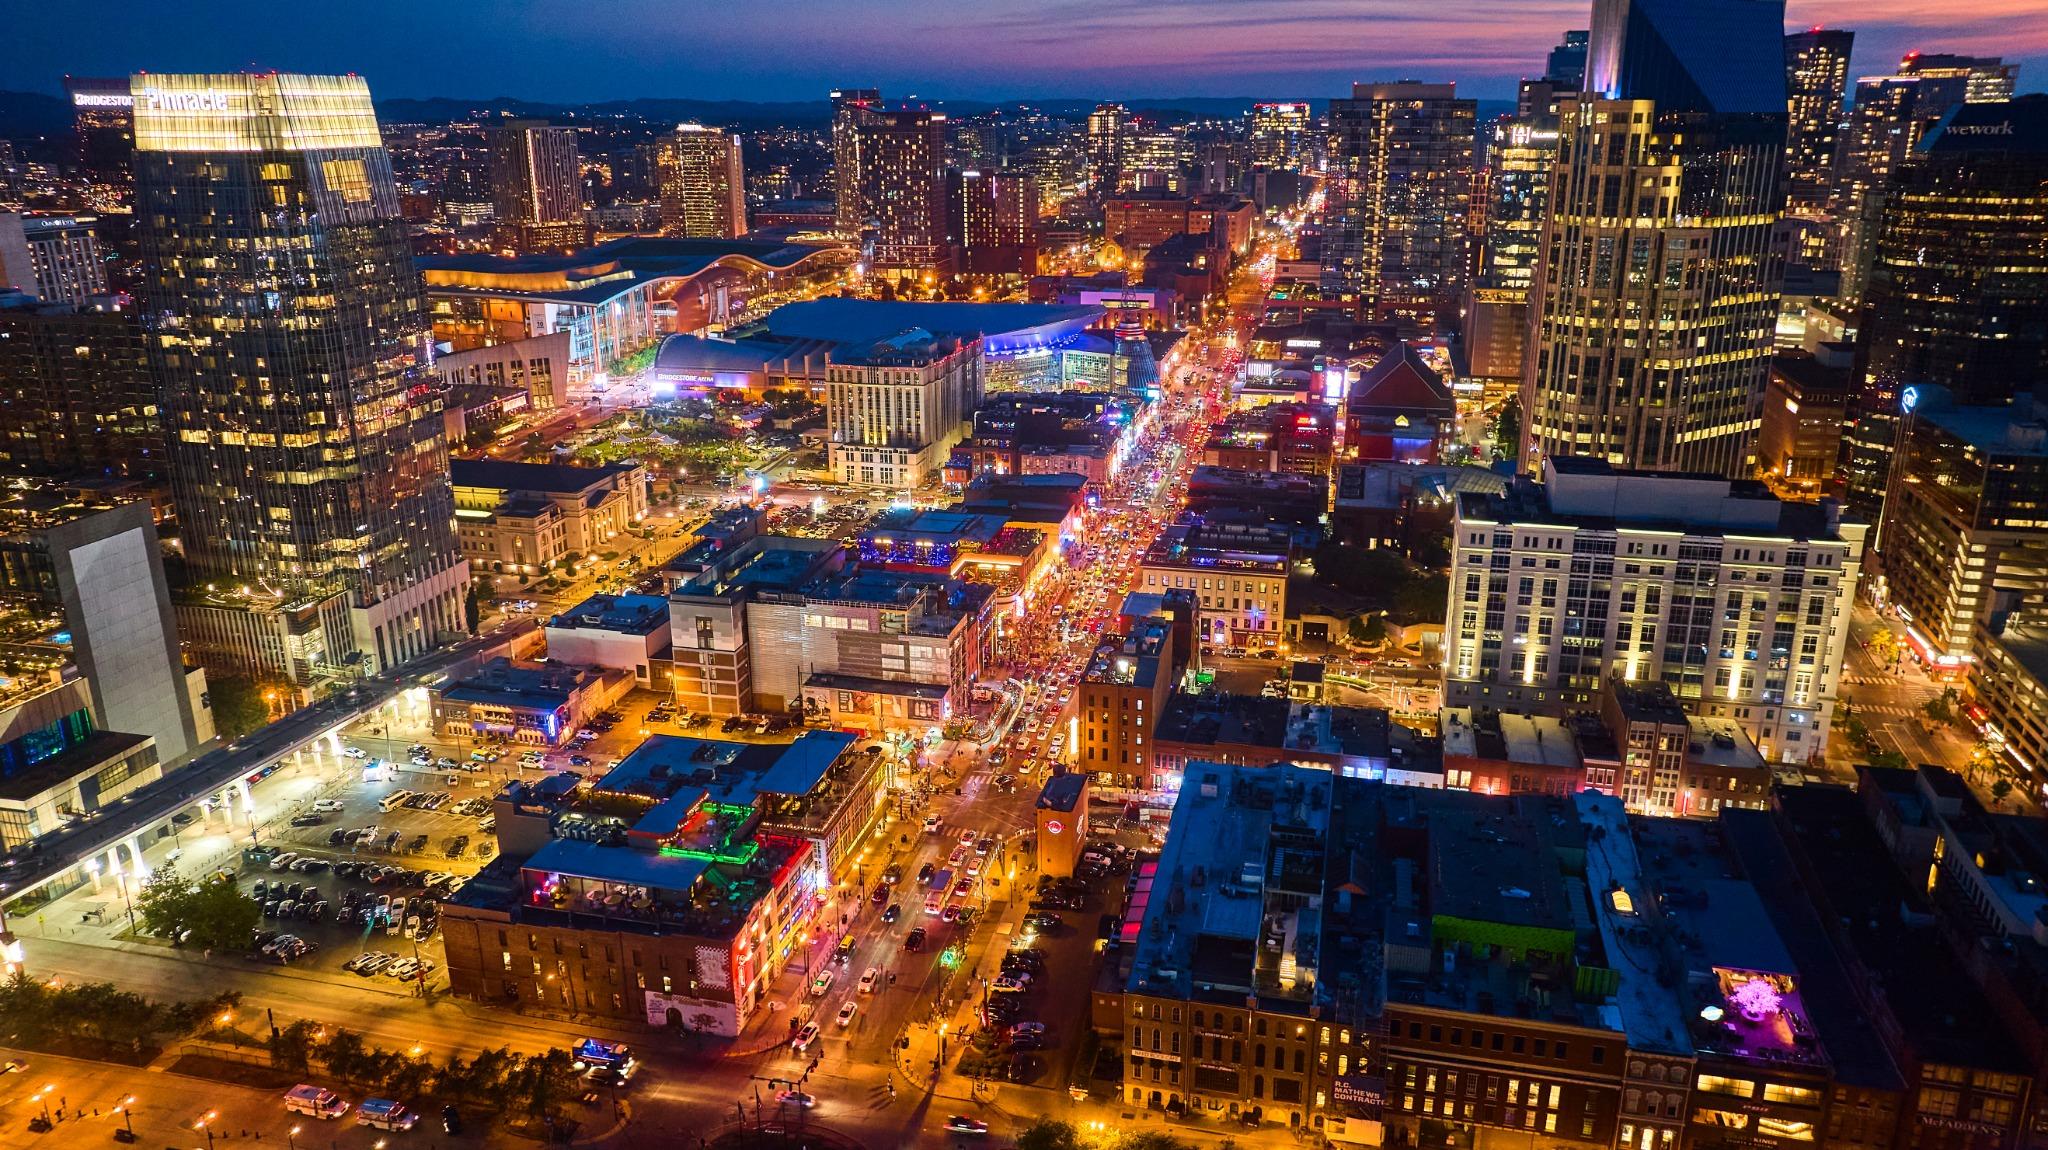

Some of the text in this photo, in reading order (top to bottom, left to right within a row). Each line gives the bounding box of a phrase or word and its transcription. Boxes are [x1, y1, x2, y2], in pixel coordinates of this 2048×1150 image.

[74, 93, 134, 106] BRIDGESTON
[144, 87, 228, 110] Pinnacle
[1946, 120, 2014, 135] wework
[657, 373, 697, 382] BRIDGESTONE
[1334, 1080, 1352, 1088] R.C.
[1334, 1087, 1380, 1099] MATHEWS
